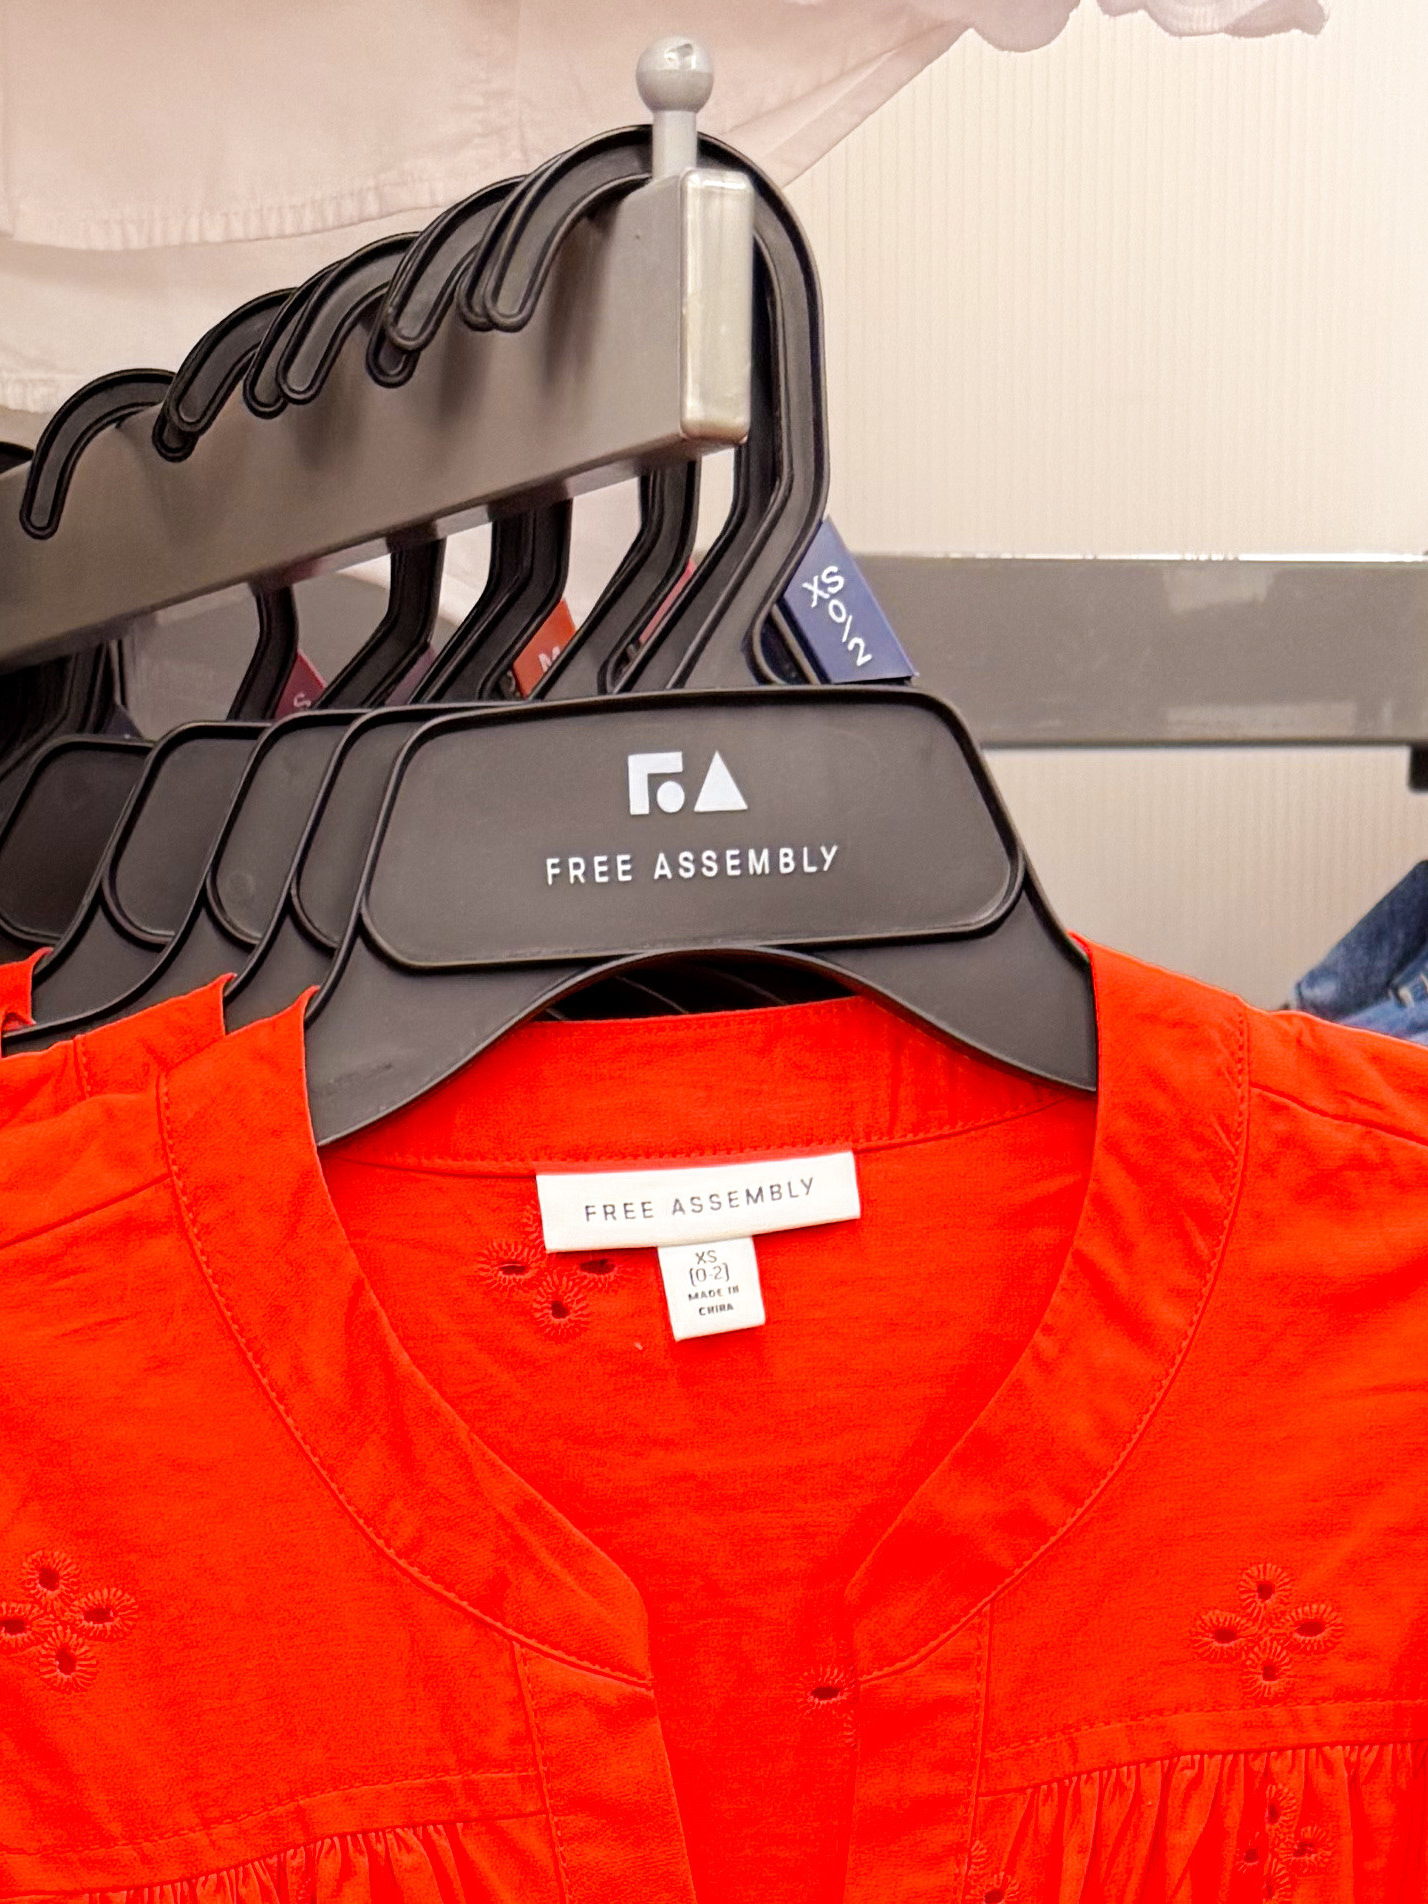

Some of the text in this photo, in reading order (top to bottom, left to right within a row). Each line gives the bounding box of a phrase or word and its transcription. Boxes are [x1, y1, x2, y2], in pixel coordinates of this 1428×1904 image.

[802, 566, 844, 608] XS
[828, 599, 872, 666] 0/2
[546, 845, 838, 885] FREE ASSEMBLY
[584, 1176, 815, 1222] FREE ASSEMBLY
[695, 1249, 718, 1265] XS
[687, 1288, 724, 1302] MADE
[698, 1303, 734, 1317] CHINA
